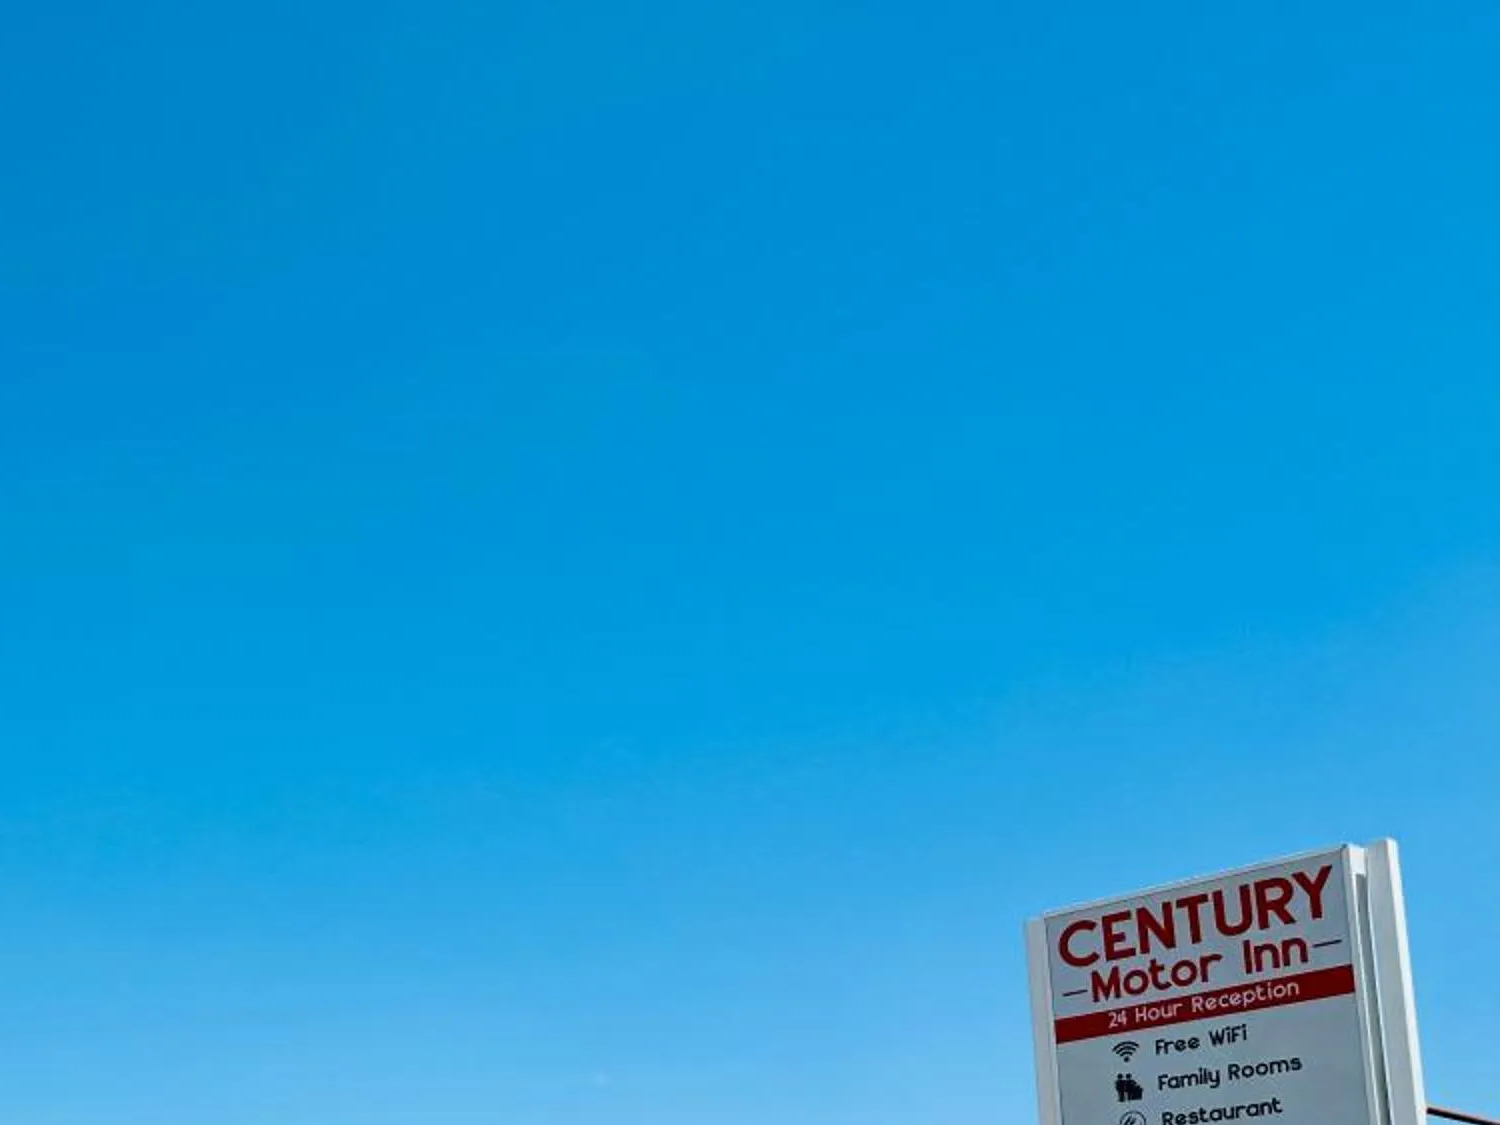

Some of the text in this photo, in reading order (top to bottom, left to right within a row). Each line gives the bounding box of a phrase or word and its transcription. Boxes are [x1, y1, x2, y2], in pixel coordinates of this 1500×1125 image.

[1058, 864, 1334, 968] CENTURY
[1091, 936, 1309, 1003] Motor Inn
[1107, 980, 1300, 1030] 24 Hour Reception
[1155, 1023, 1248, 1056] Free WiFi
[1157, 1056, 1303, 1092] Family Rooms
